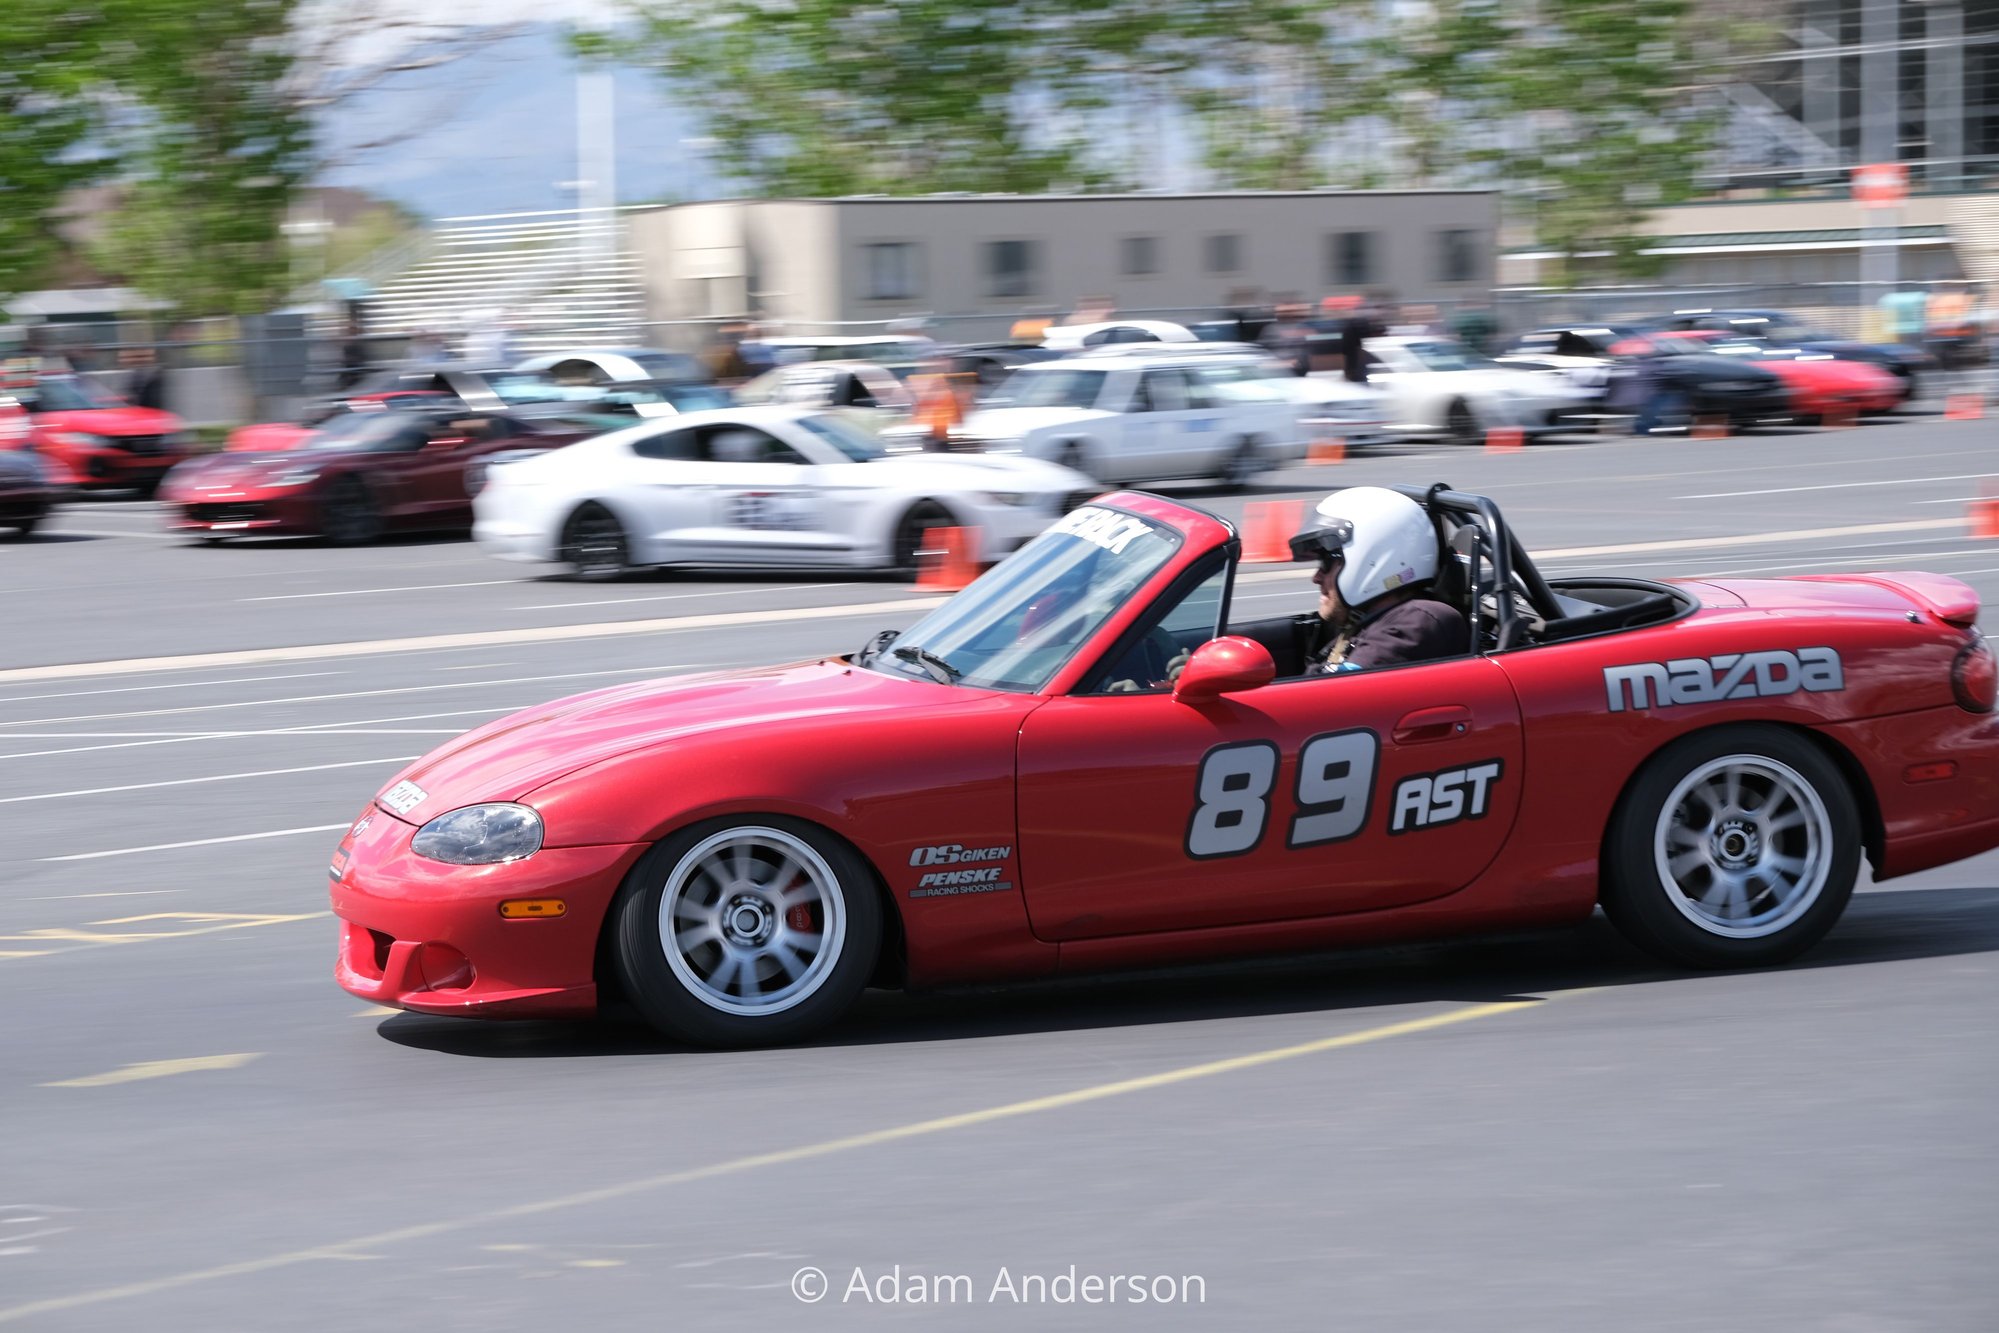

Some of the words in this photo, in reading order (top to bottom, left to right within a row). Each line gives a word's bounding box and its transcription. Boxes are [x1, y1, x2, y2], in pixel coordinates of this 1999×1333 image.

[1187, 730, 1379, 857] 89
[1391, 761, 1500, 832] AST
[918, 867, 1002, 888] PENSKE
[927, 886, 959, 897] RACING
[960, 883, 995, 894] SHOCKS
